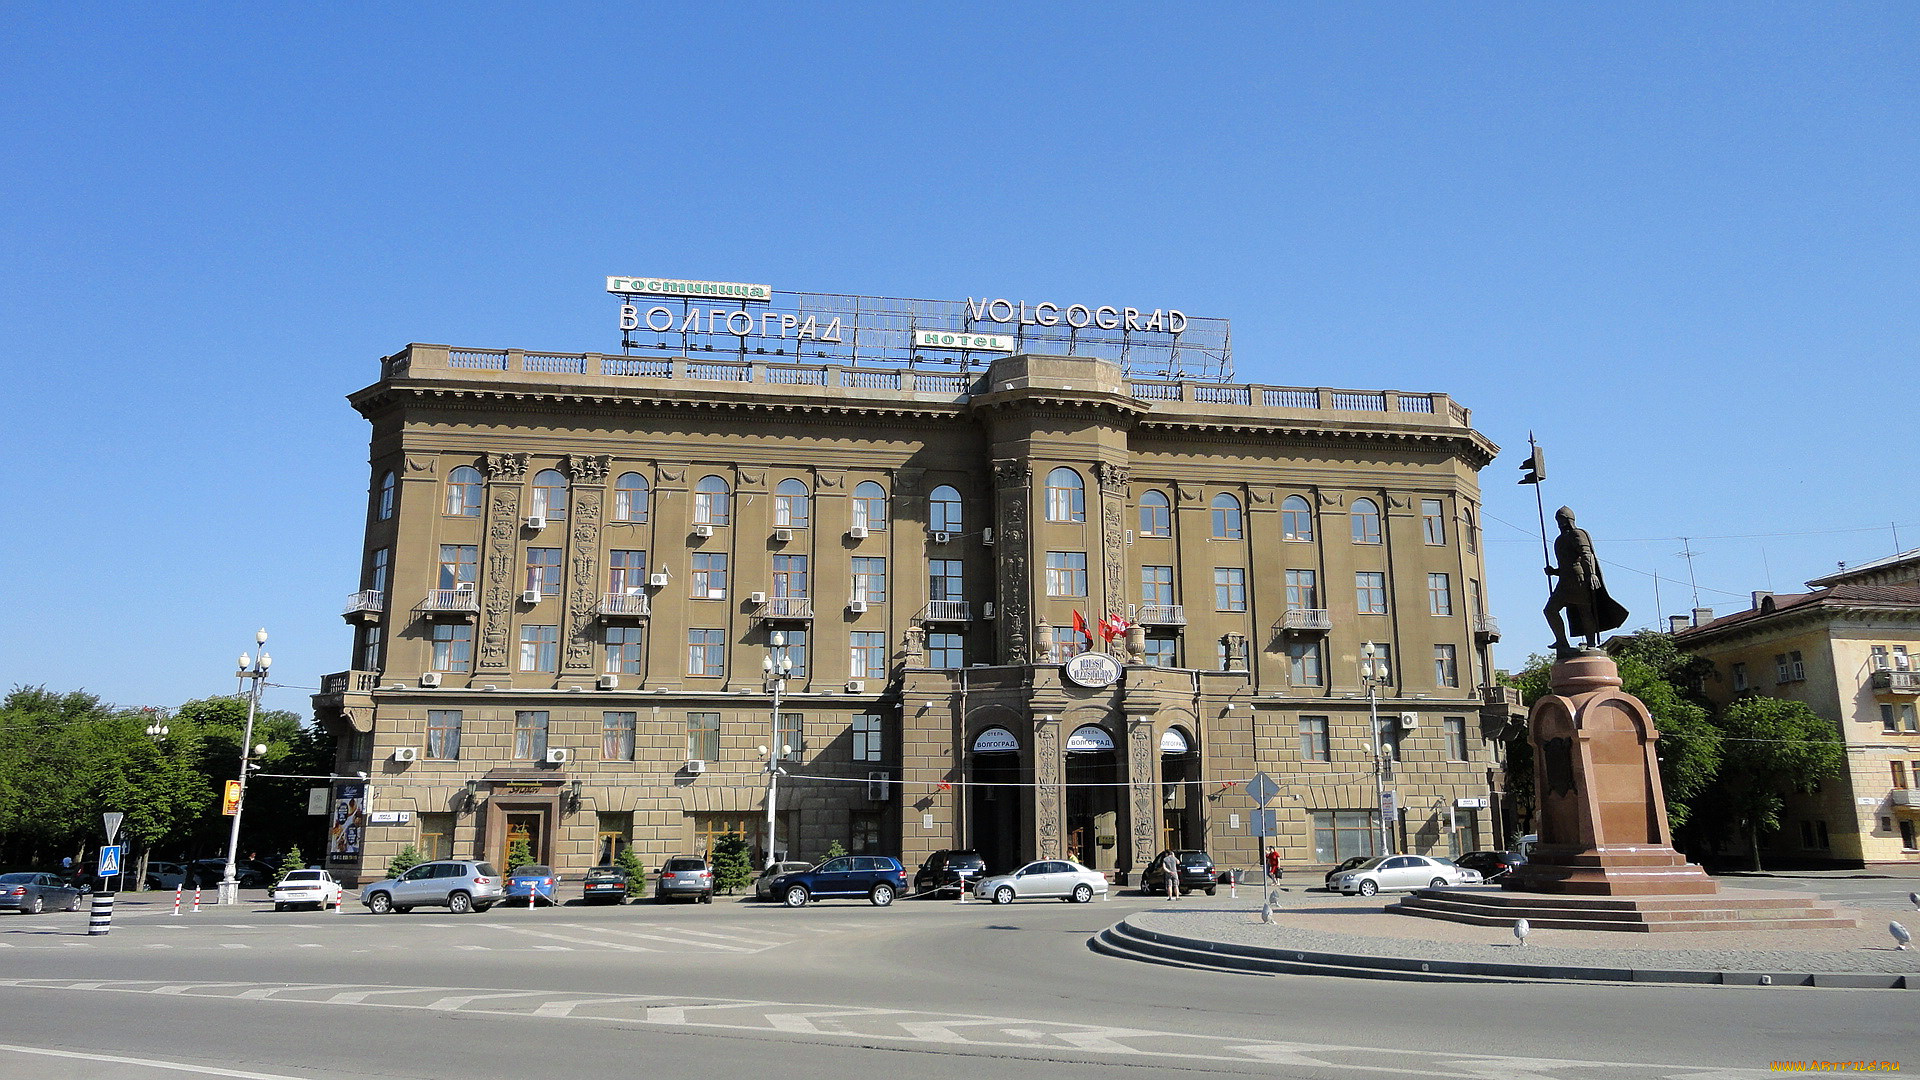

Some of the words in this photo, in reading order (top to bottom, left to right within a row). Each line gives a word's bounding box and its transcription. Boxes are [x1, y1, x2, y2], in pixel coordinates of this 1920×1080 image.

[967, 296, 1188, 334] VOLGOGRAD
[619, 304, 842, 342] ВОЛГОГРАД
[1080, 659, 1105, 670] BEST
[976, 740, 1015, 748] ВОЛГОГРАД
[1071, 739, 1110, 747] ВОЛГОГРАД
